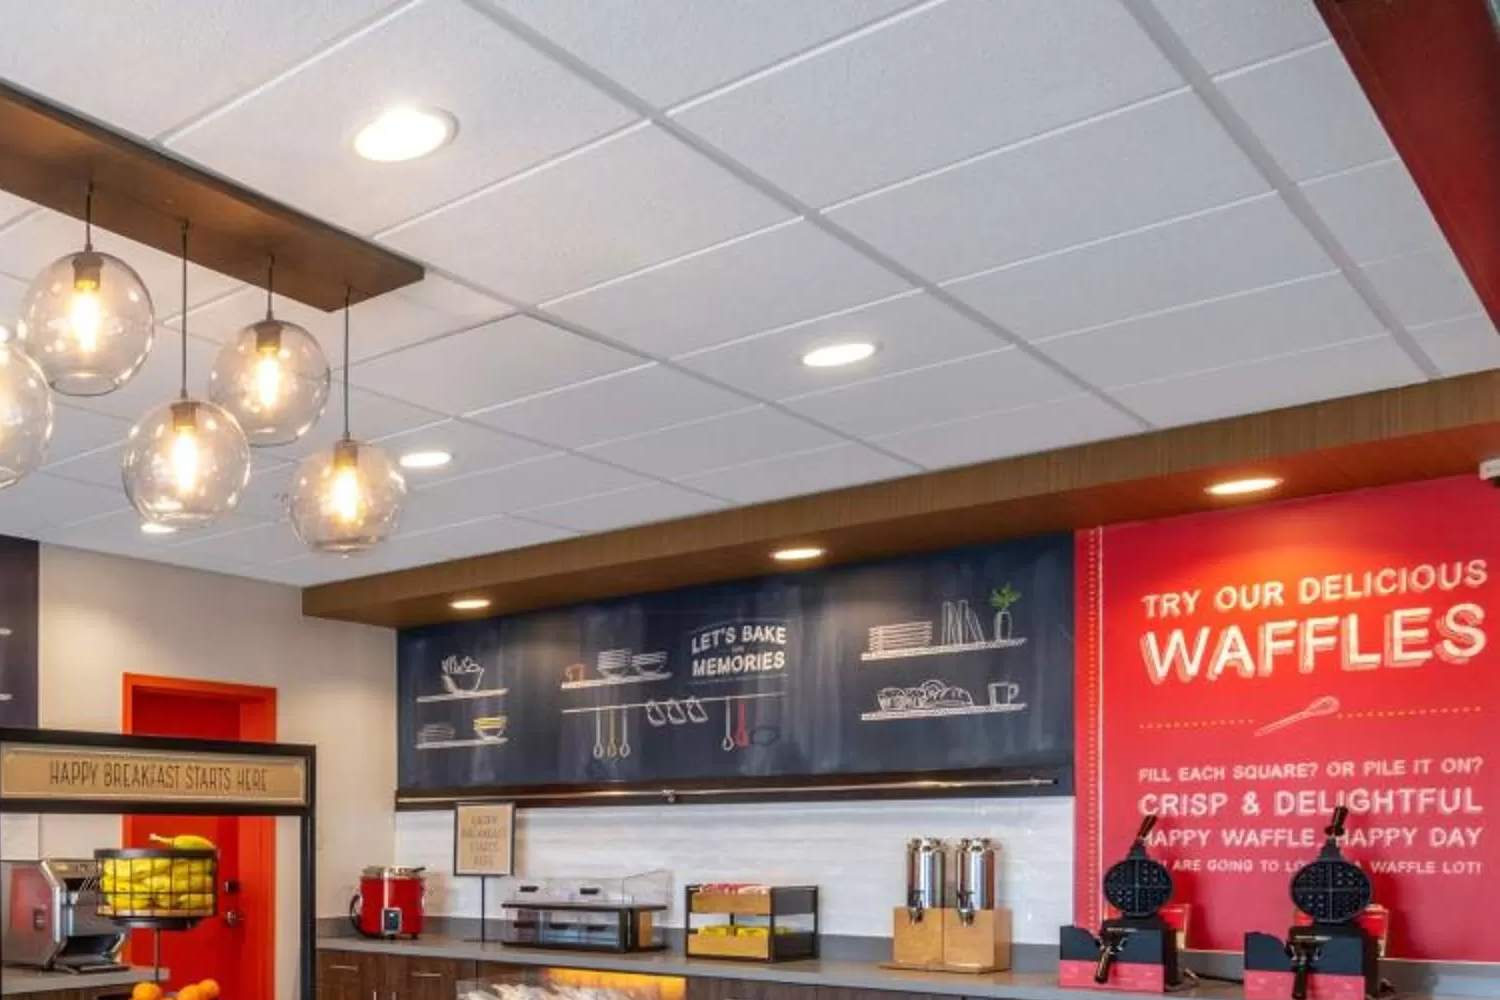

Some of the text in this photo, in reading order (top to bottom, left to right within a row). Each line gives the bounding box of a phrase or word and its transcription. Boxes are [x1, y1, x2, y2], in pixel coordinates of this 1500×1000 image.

[1141, 559, 1488, 621] TRY OUR DELICIOUS
[691, 625, 787, 655] LET'S BAKE
[1140, 603, 1488, 685] WAFFLES
[691, 650, 785, 677] MEMORIES
[50, 759, 268, 793] HAPPY BREAKFAST STARTS HERE
[1138, 756, 1484, 784] FILL EACH SQUARE? OR PILE IT ON?
[1138, 787, 1483, 817] CRISP & DELIGHTFUL
[1429, 826, 1483, 848] DAY
[1172, 859, 1201, 872] ARE
[1207, 859, 1253, 873] GOING
[1260, 859, 1280, 873] TO
[1371, 860, 1435, 874] WAFFLE
